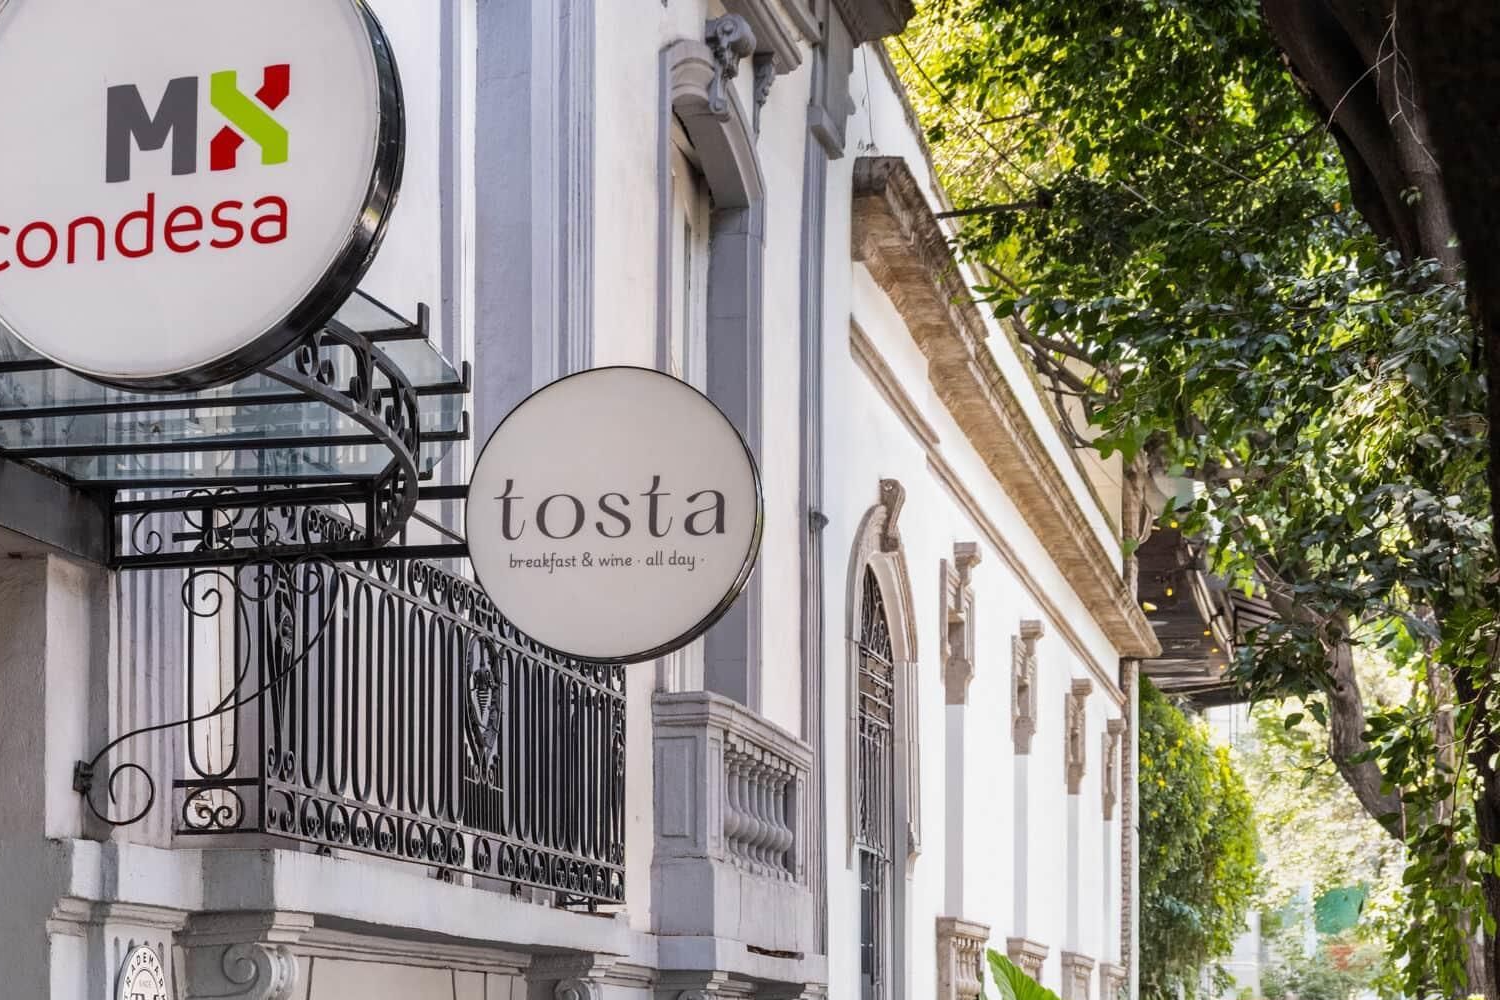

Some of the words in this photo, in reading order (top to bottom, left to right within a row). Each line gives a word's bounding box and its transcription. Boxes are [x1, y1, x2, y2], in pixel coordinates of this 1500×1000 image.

[105, 63, 291, 183] MX
[493, 475, 726, 541] tosta
[509, 551, 577, 574] breakfast
[581, 552, 595, 567] &
[598, 552, 633, 567] wine
[645, 550, 664, 566] all
[668, 550, 696, 572] day
